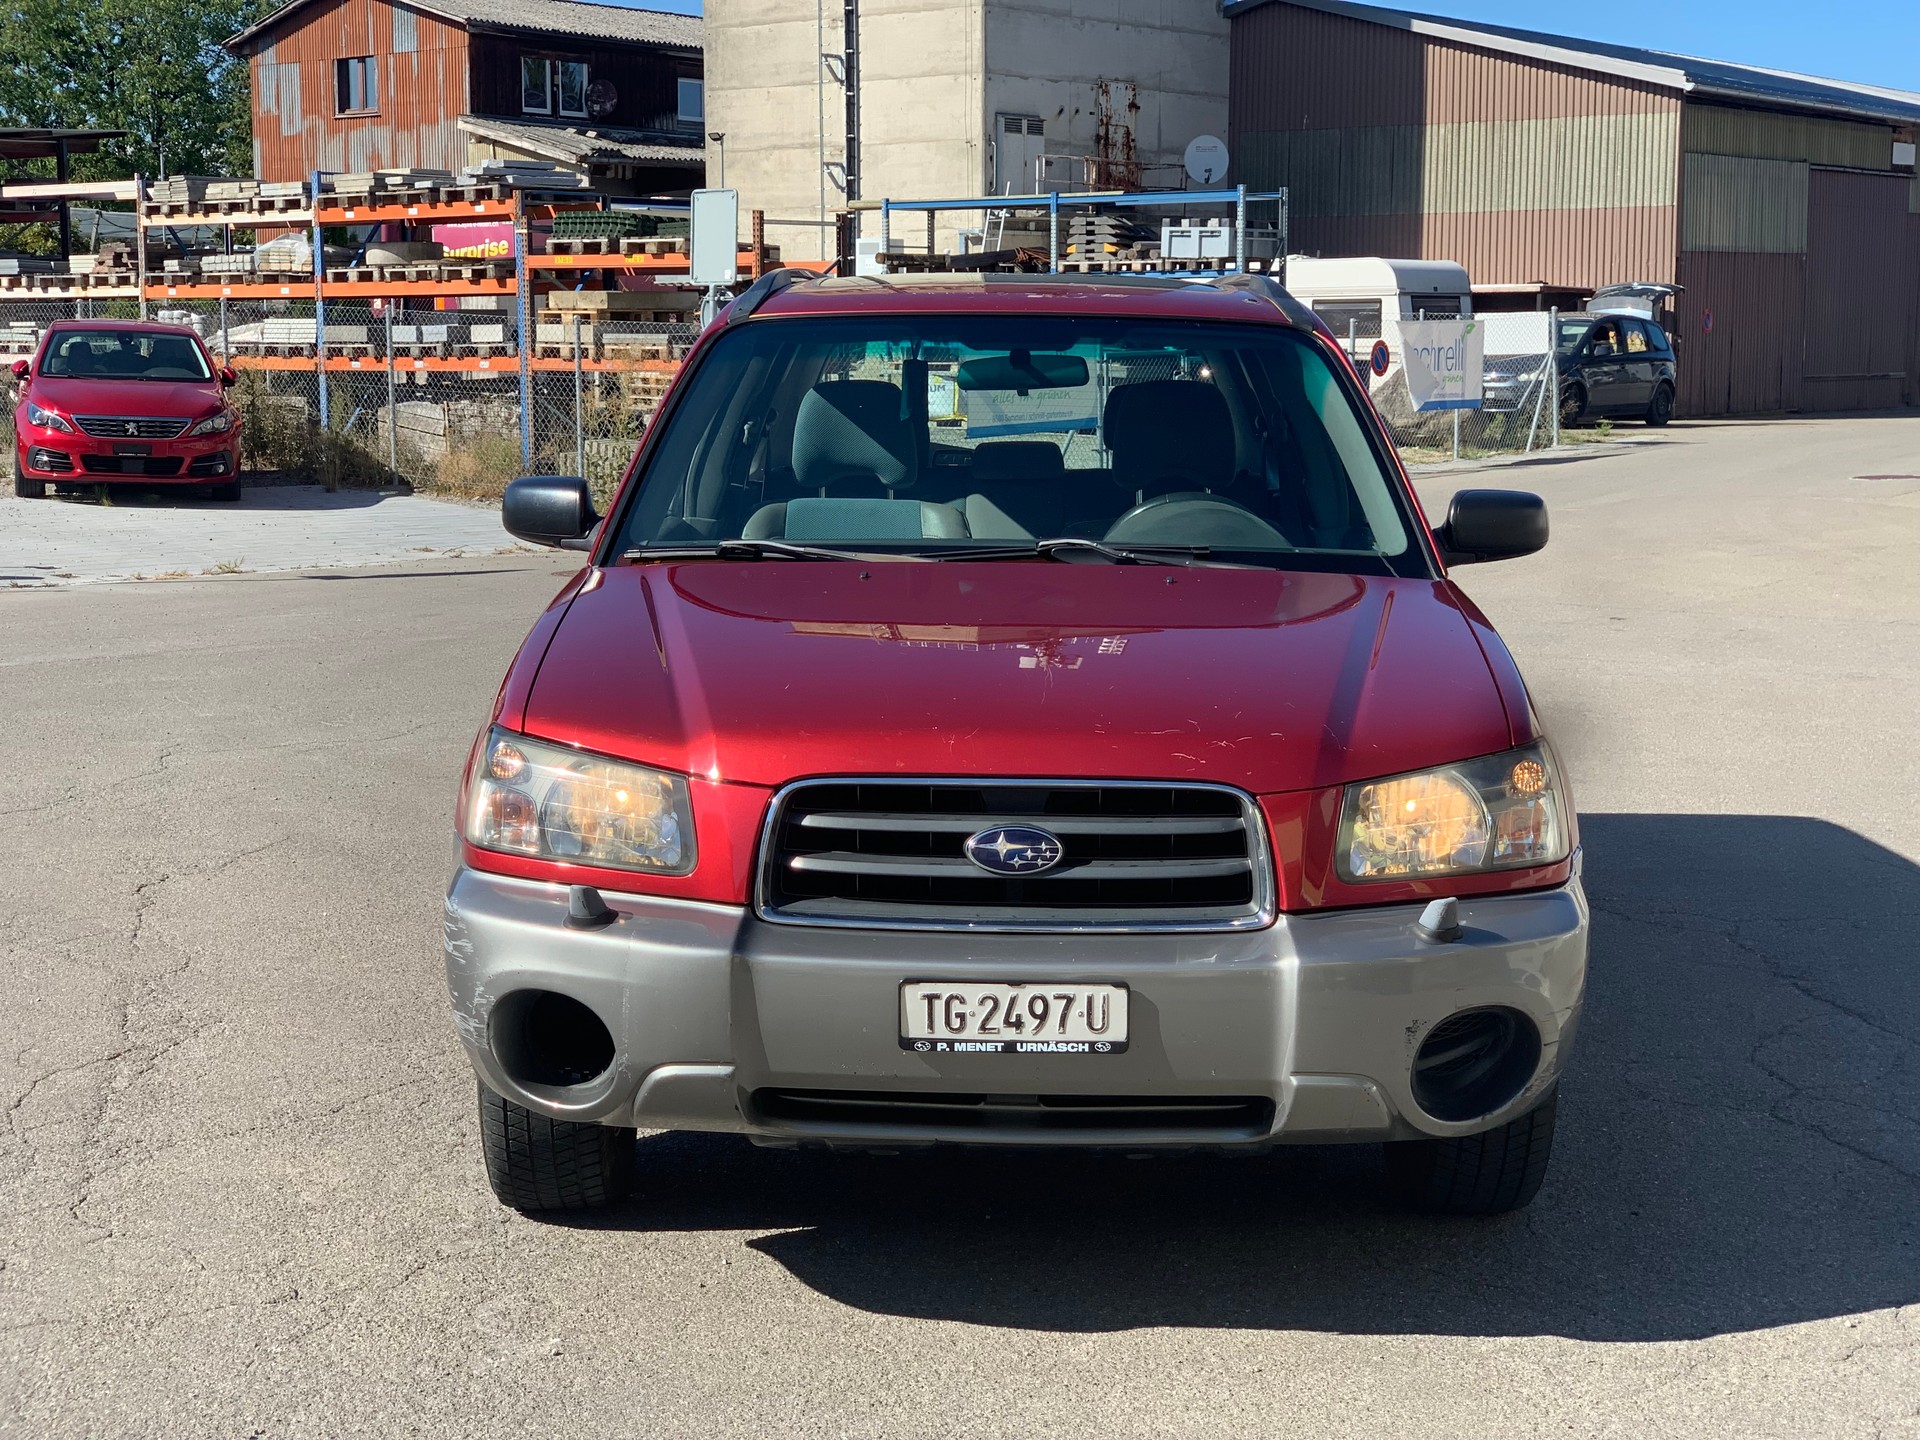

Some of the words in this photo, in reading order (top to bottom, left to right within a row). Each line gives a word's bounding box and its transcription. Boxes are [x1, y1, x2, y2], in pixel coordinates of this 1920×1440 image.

[919, 993, 967, 1034] TG
[977, 993, 1075, 1035] 2497
[1086, 993, 1109, 1035] U
[937, 1043, 949, 1052] P.
[954, 1043, 1004, 1052] MENET
[1017, 1041, 1089, 1052] URNÄSCH
